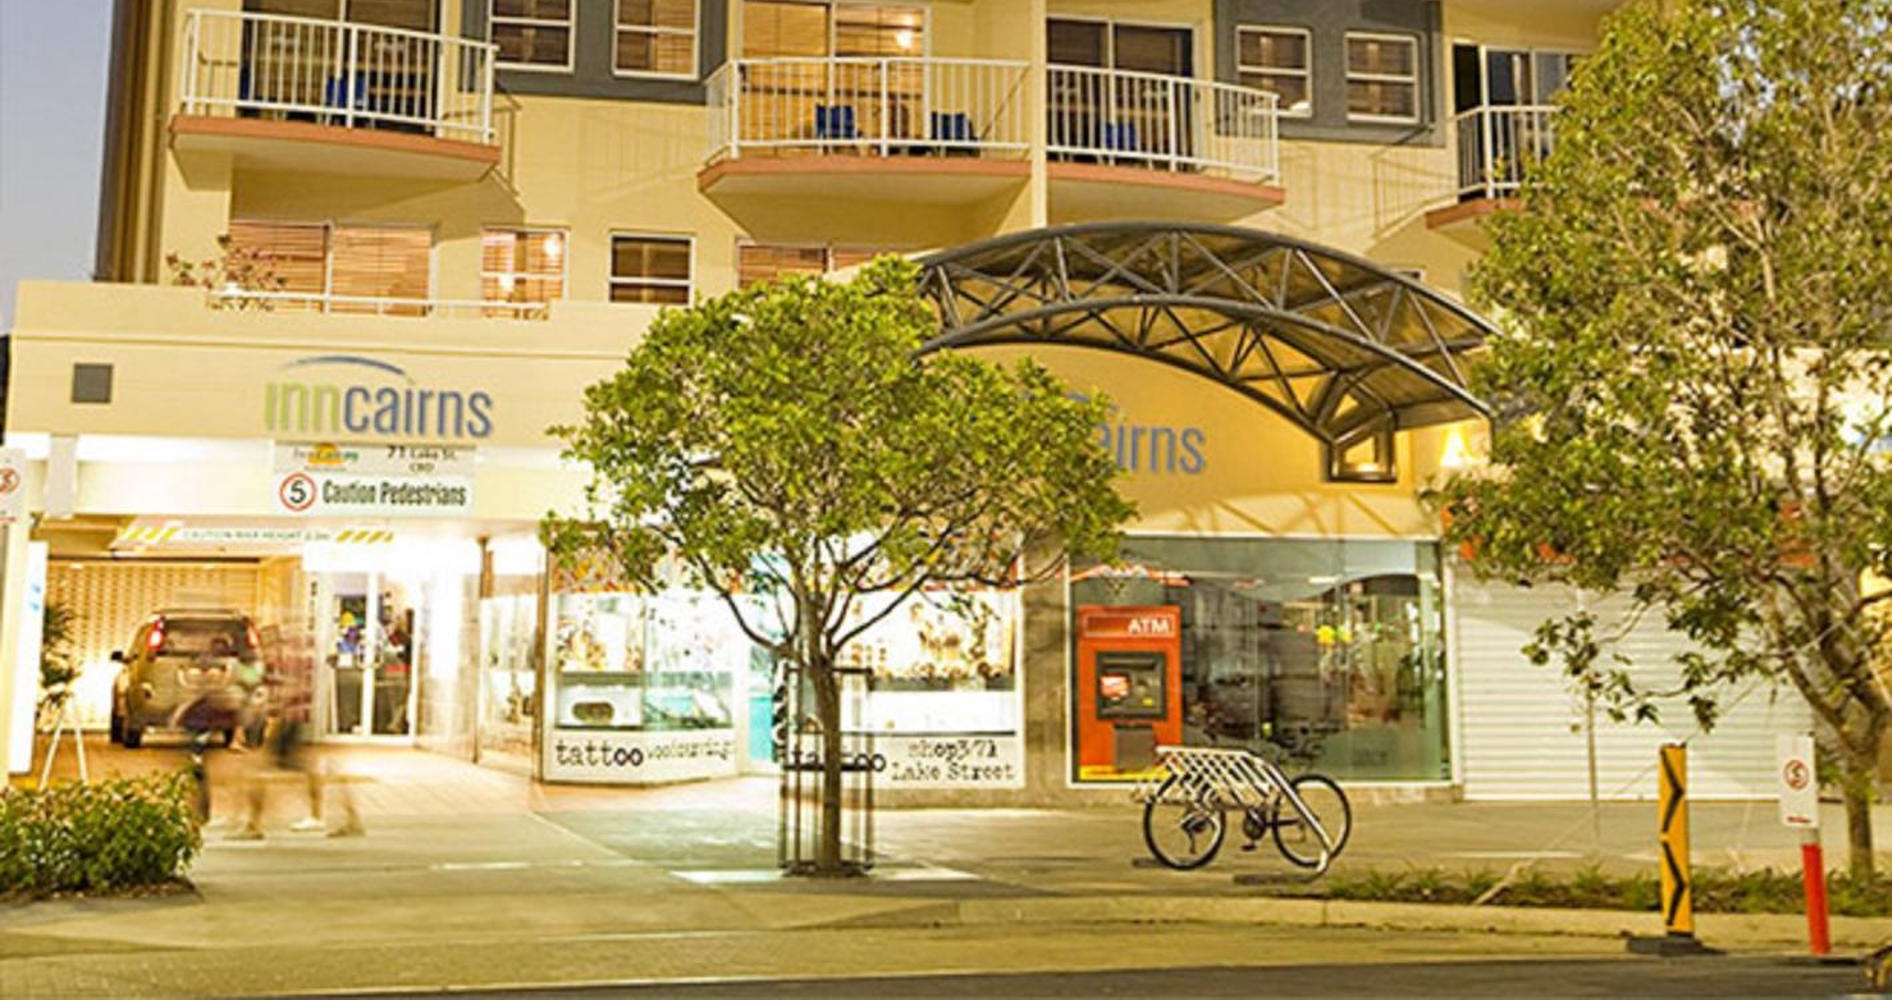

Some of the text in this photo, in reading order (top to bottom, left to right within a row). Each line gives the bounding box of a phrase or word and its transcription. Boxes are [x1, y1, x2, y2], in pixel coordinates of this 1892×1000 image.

[289, 479, 467, 506] 5 Caution Pedestrians
[1128, 618, 1170, 635] ATM
[555, 739, 645, 767] tattoo
[792, 743, 887, 772] taoo
[946, 761, 1015, 781] Street
